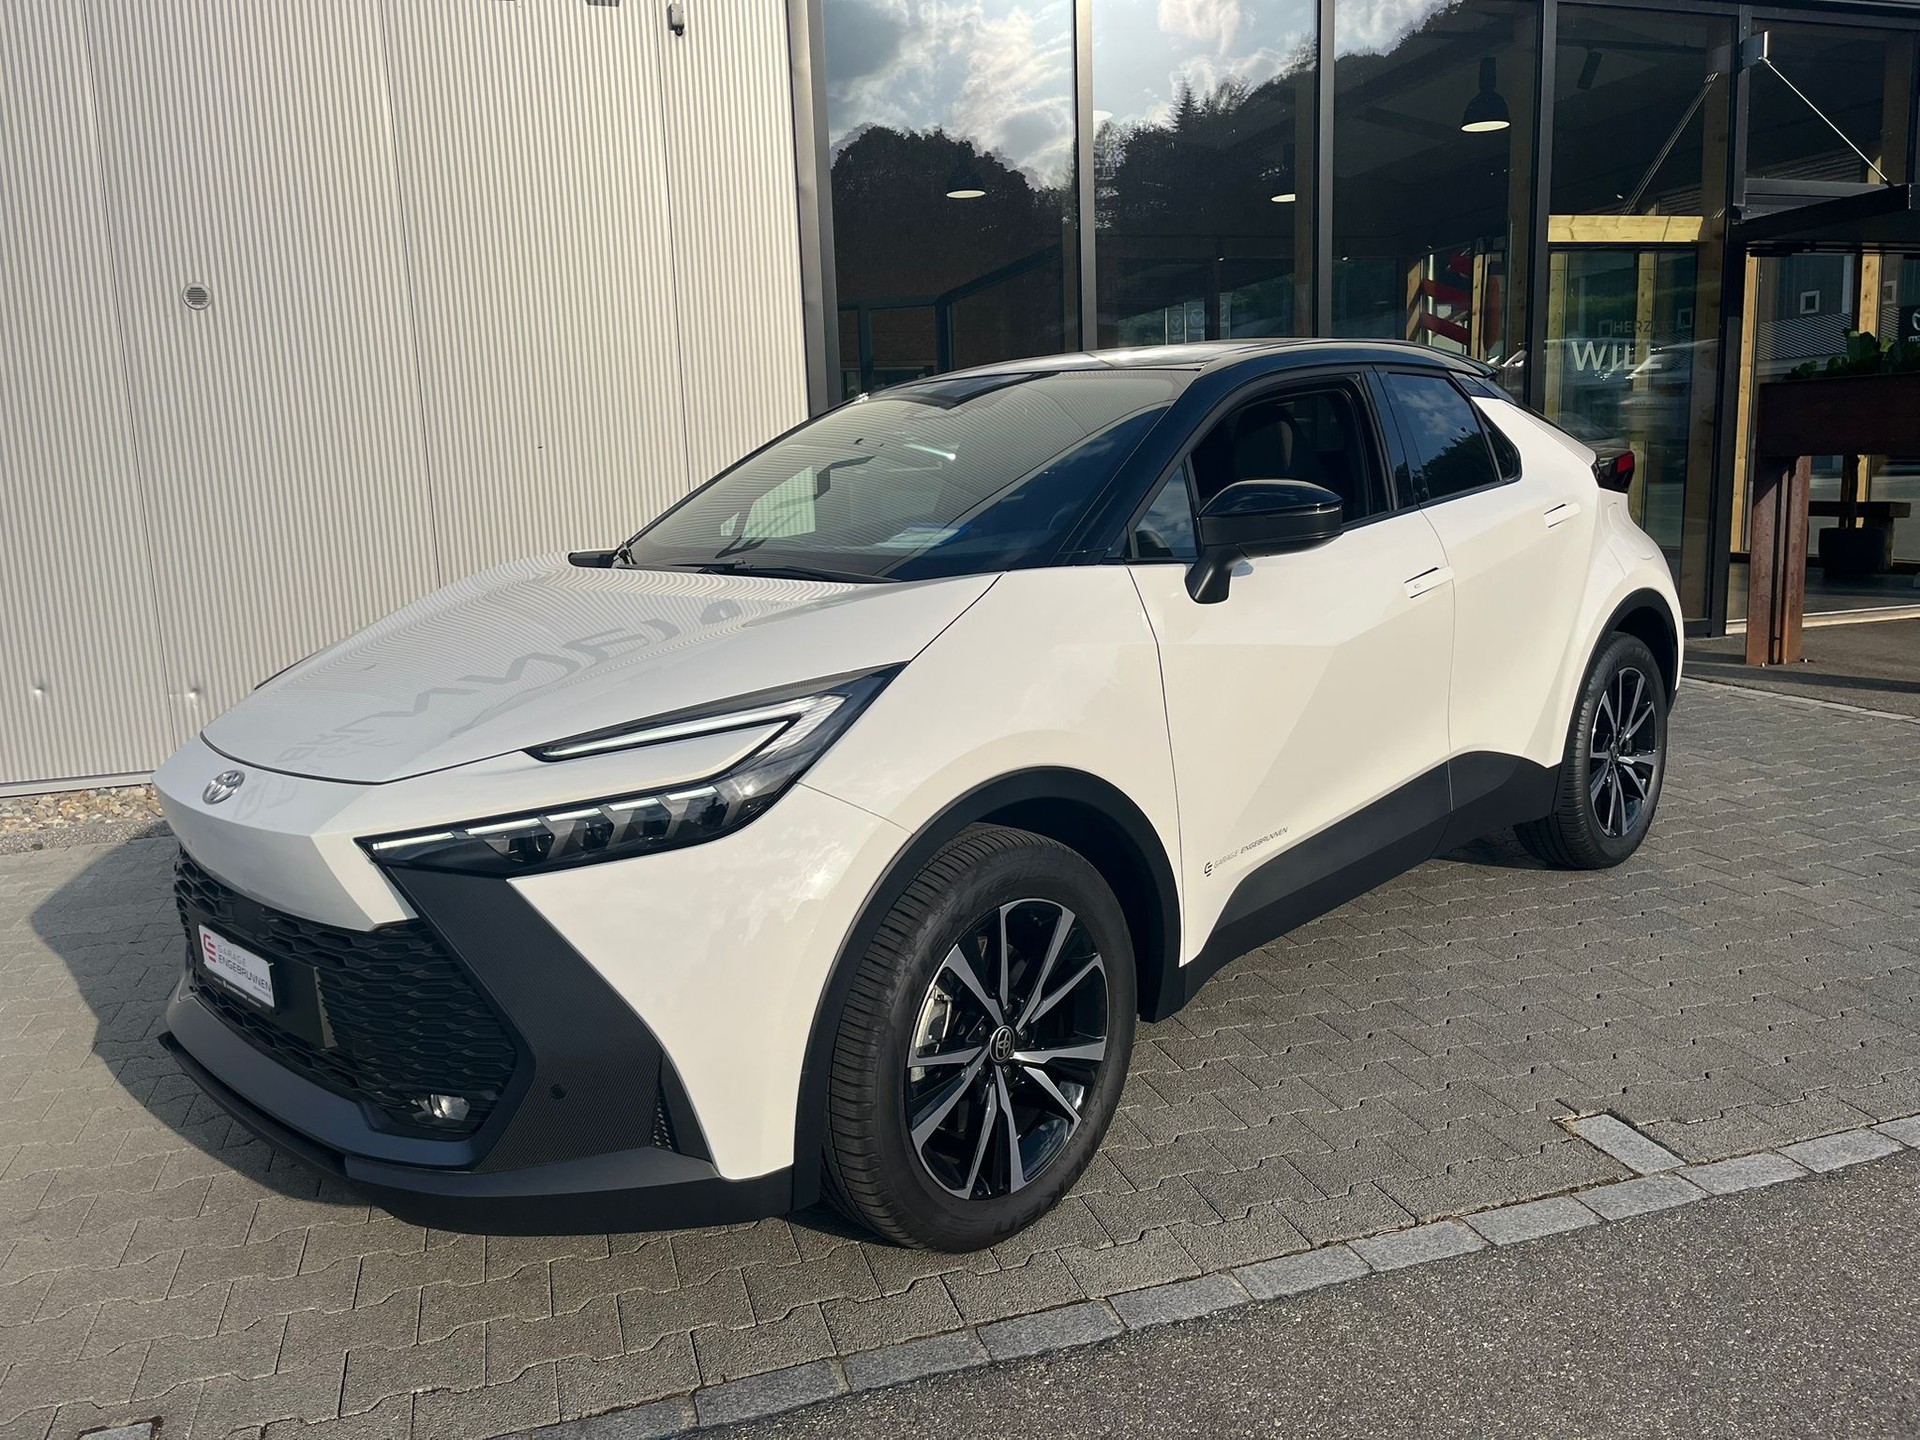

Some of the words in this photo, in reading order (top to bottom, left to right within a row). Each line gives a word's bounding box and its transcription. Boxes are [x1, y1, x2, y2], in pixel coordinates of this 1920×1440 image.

[1213, 849, 1239, 869] GARAGE
[1240, 826, 1289, 854] ENGEBRUNNEN
[217, 945, 248, 967] GARAGE
[218, 954, 272, 992] ENGEBRUNNEN
